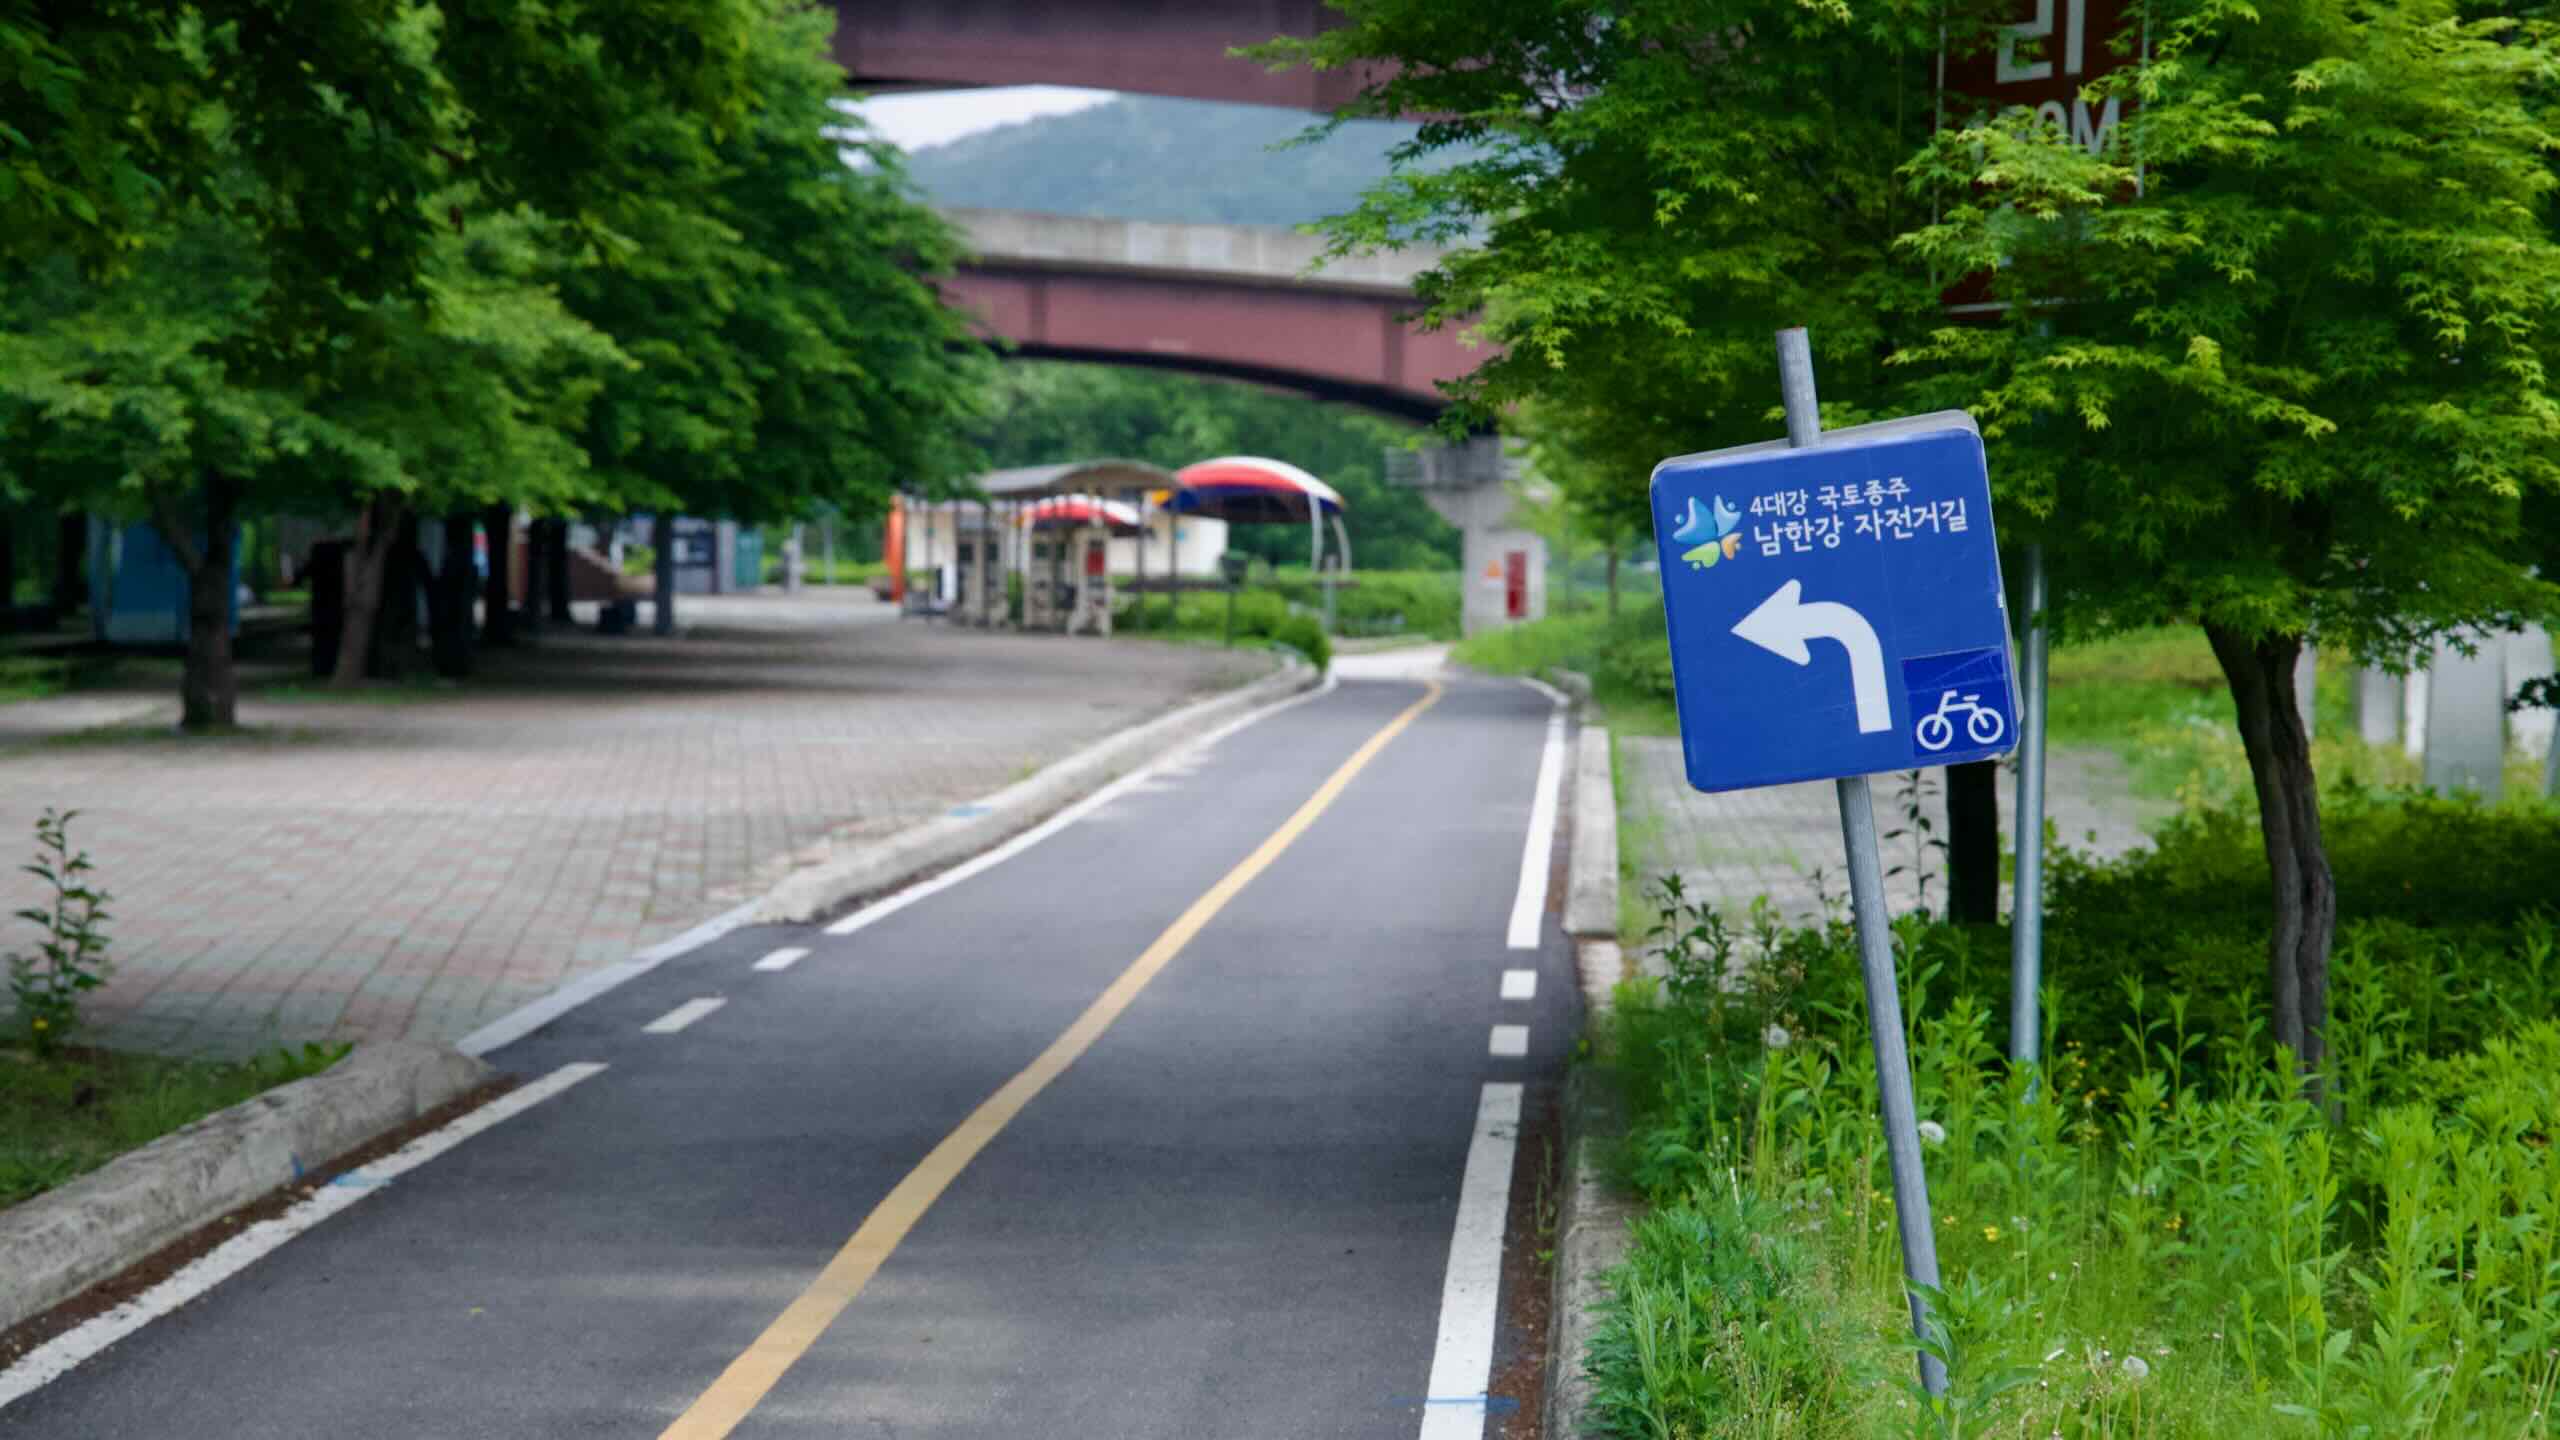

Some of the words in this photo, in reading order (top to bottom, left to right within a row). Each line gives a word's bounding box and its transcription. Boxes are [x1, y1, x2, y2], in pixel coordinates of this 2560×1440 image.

[1750, 488, 1808, 517] 4대강
[1816, 477, 1911, 511] 국토종주
[1754, 513, 1845, 556] 남한강
[1854, 496, 1969, 542] 자전거길
